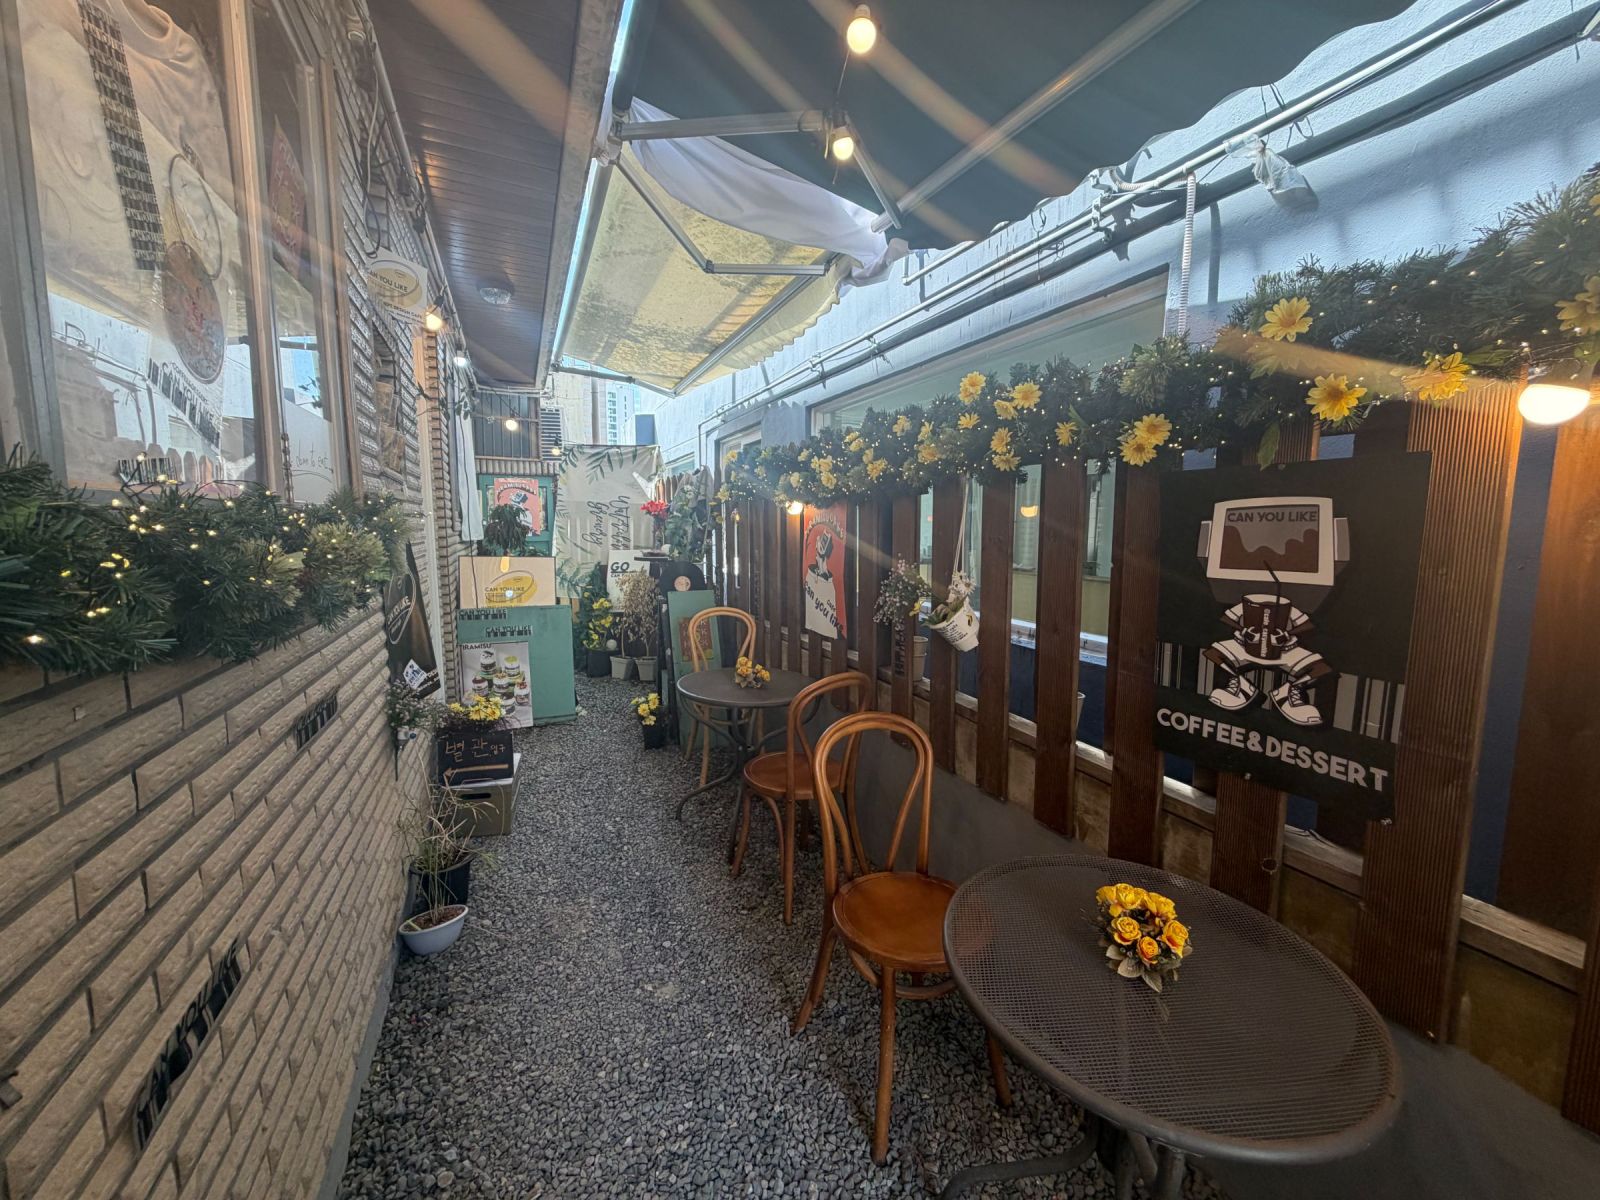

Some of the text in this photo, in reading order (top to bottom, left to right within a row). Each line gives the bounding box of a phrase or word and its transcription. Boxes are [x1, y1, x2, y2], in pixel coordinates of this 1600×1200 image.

[1227, 511, 1318, 523] CAN YOU LIKE
[610, 561, 630, 573] GO
[815, 598, 830, 618] you
[1156, 708, 1388, 792] COFFEE&DESSERT
